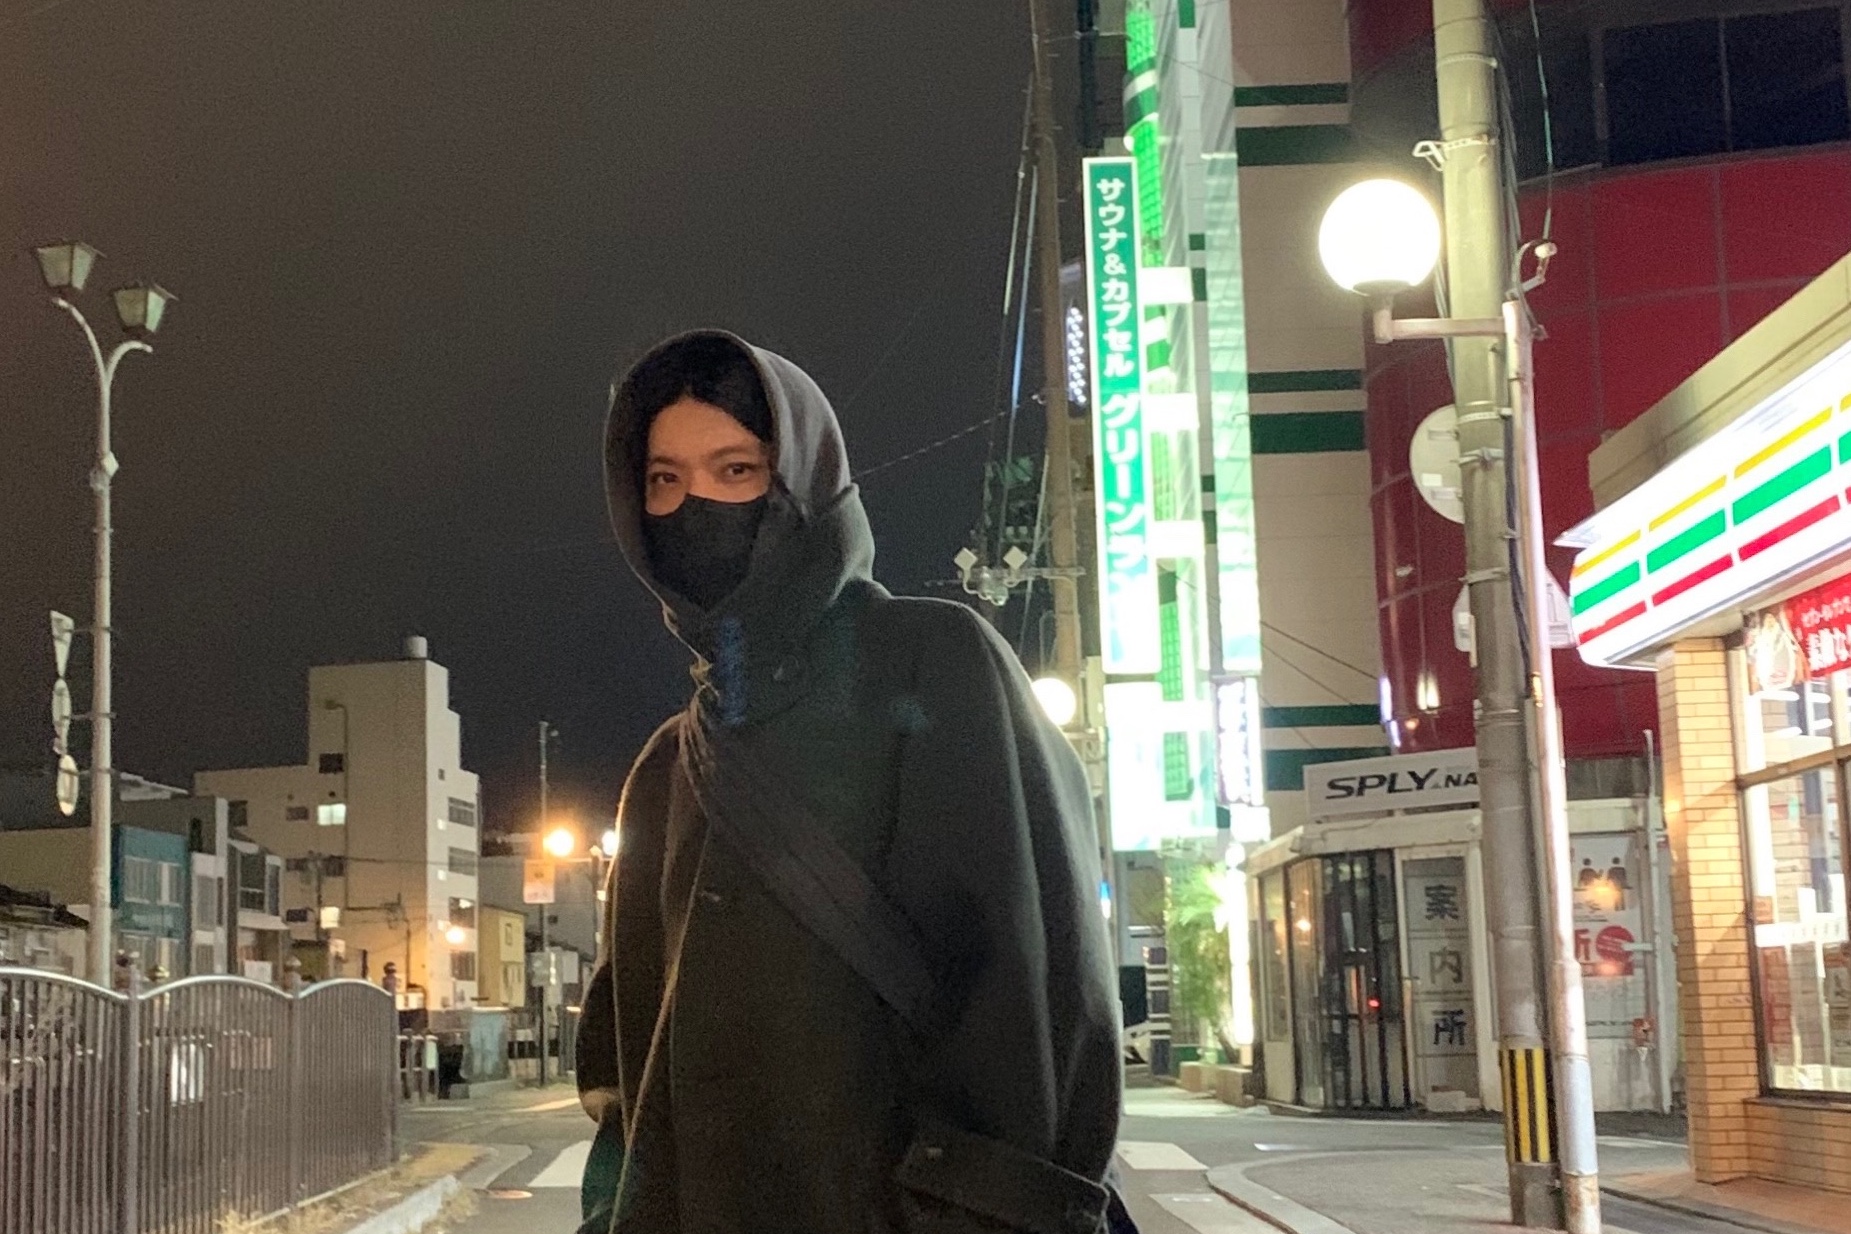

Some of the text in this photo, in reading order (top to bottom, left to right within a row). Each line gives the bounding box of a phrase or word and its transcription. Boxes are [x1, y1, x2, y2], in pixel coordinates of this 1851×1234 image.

[1325, 767, 1438, 800] SPLY
[1424, 884, 1467, 1046] 案内所
